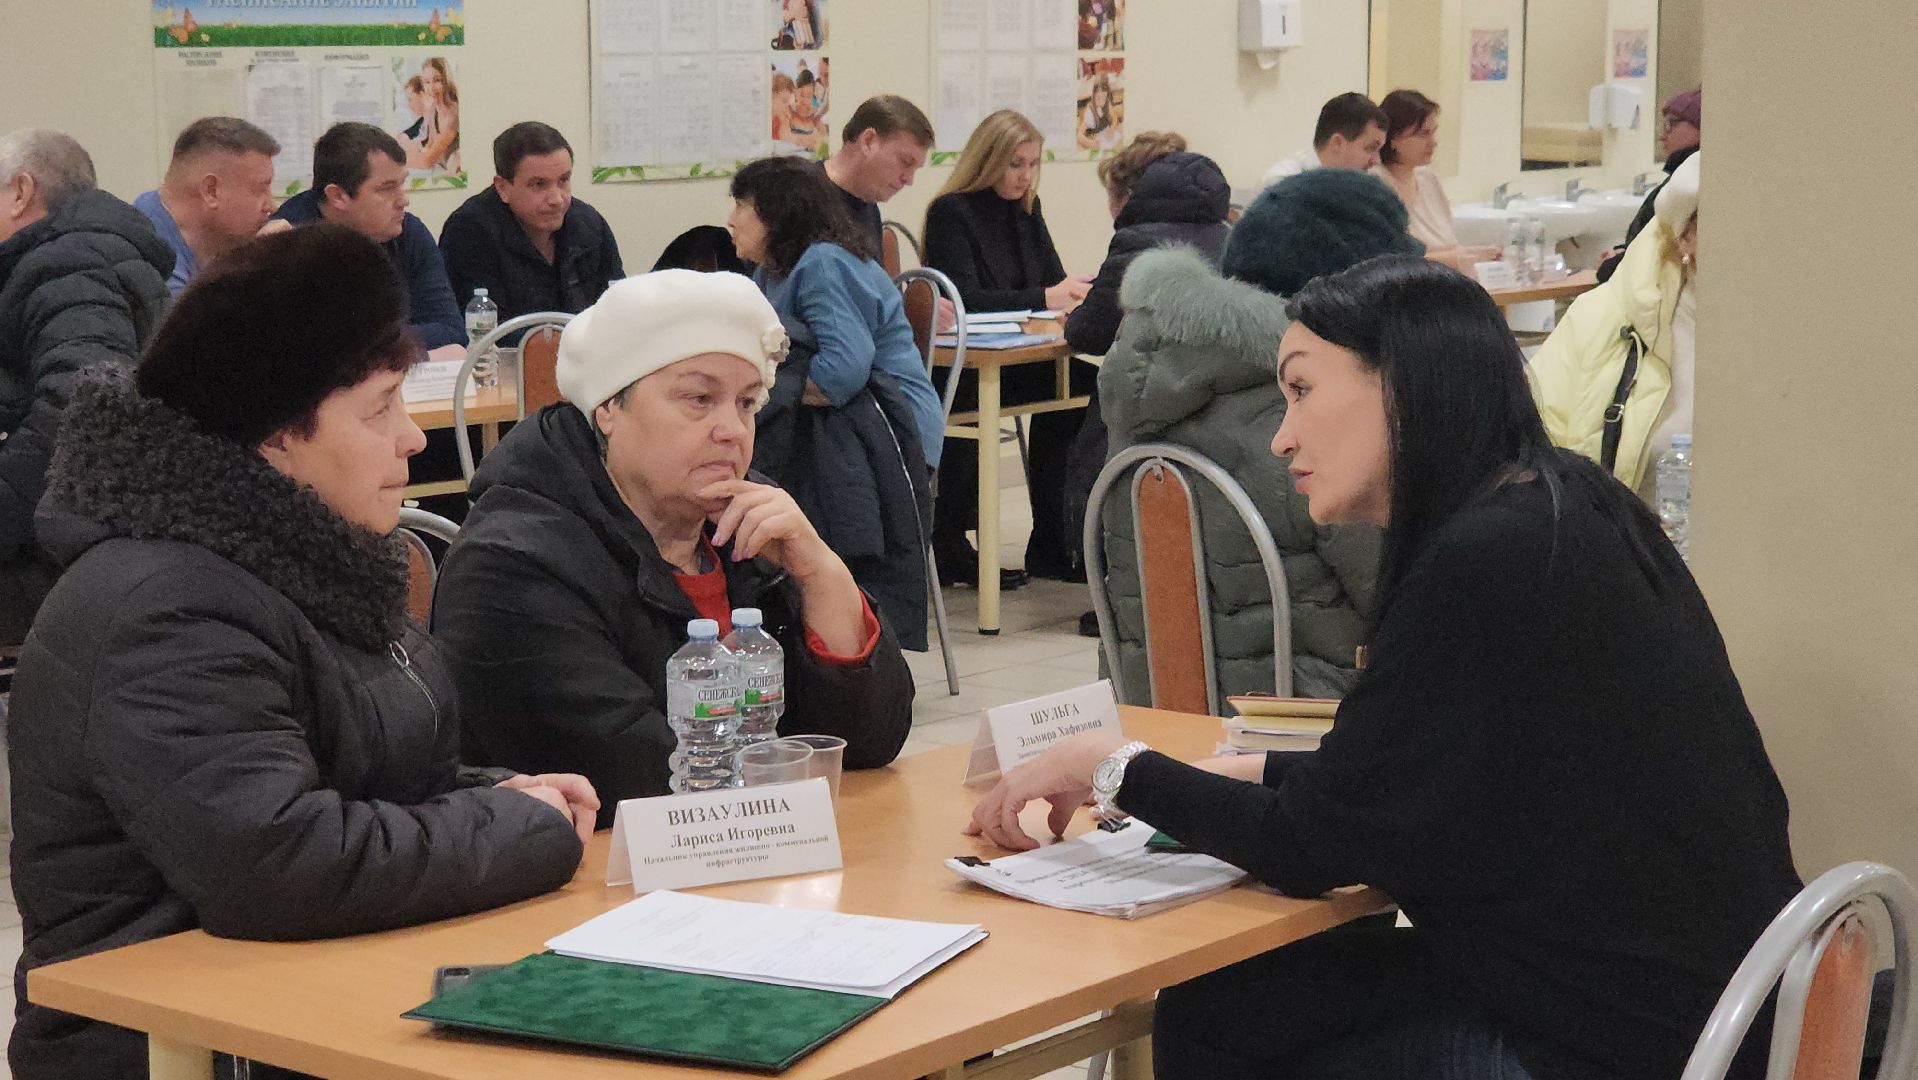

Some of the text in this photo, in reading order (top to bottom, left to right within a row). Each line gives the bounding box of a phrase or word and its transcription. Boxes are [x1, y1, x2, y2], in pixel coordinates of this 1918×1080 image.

[1030, 703, 1080, 726] ШУЛЬГА
[1017, 730, 1057, 747] Эльмира
[667, 797, 791, 826] ВИЗАУЛИНА
[670, 823, 796, 851] Лариса Игоревна
[644, 854, 688, 865] Начальник
[689, 847, 733, 859] управления
[706, 855, 769, 869] инфраструктуры
